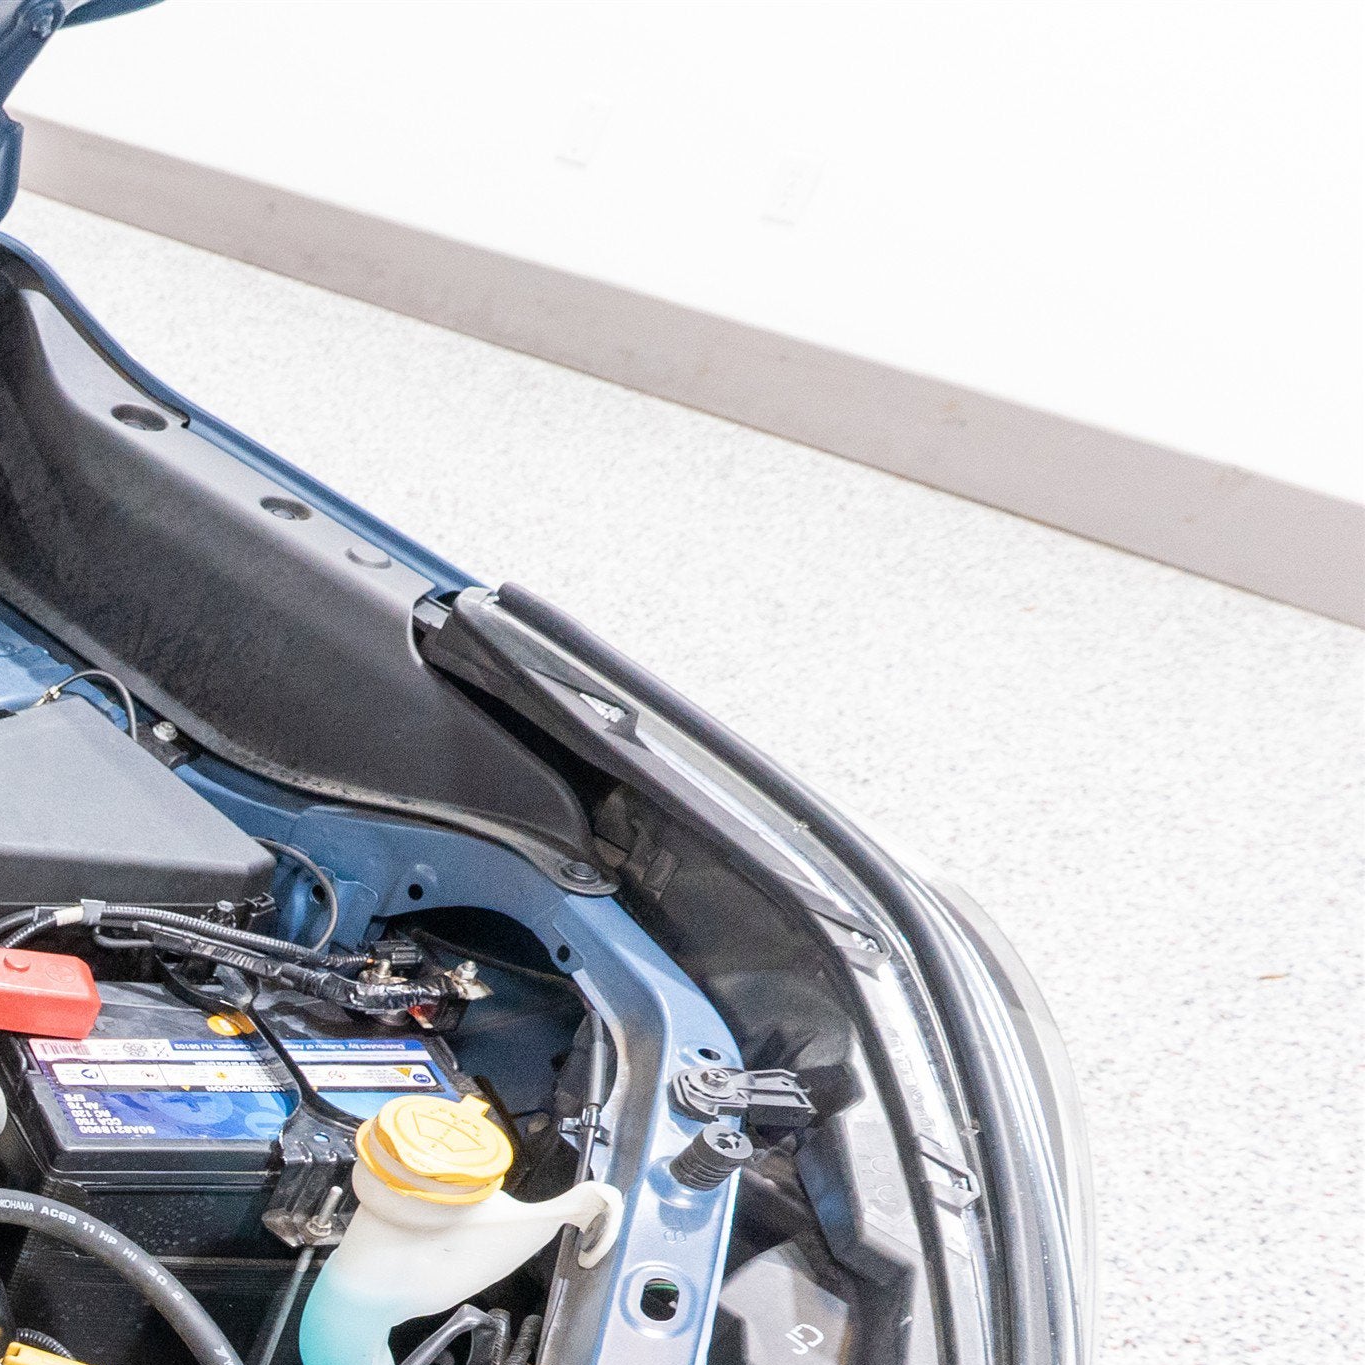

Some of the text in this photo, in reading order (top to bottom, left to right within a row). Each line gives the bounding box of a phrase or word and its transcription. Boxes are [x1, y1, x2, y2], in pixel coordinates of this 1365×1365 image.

[82, 1101, 99, 1110] Ah
[70, 1109, 112, 1118] RC 120
[74, 1117, 122, 1126] CCA 750
[82, 1220, 96, 1234] 11
[99, 1229, 118, 1246] HP
[146, 1265, 169, 1287] 30
[171, 1290, 184, 1302] 2
